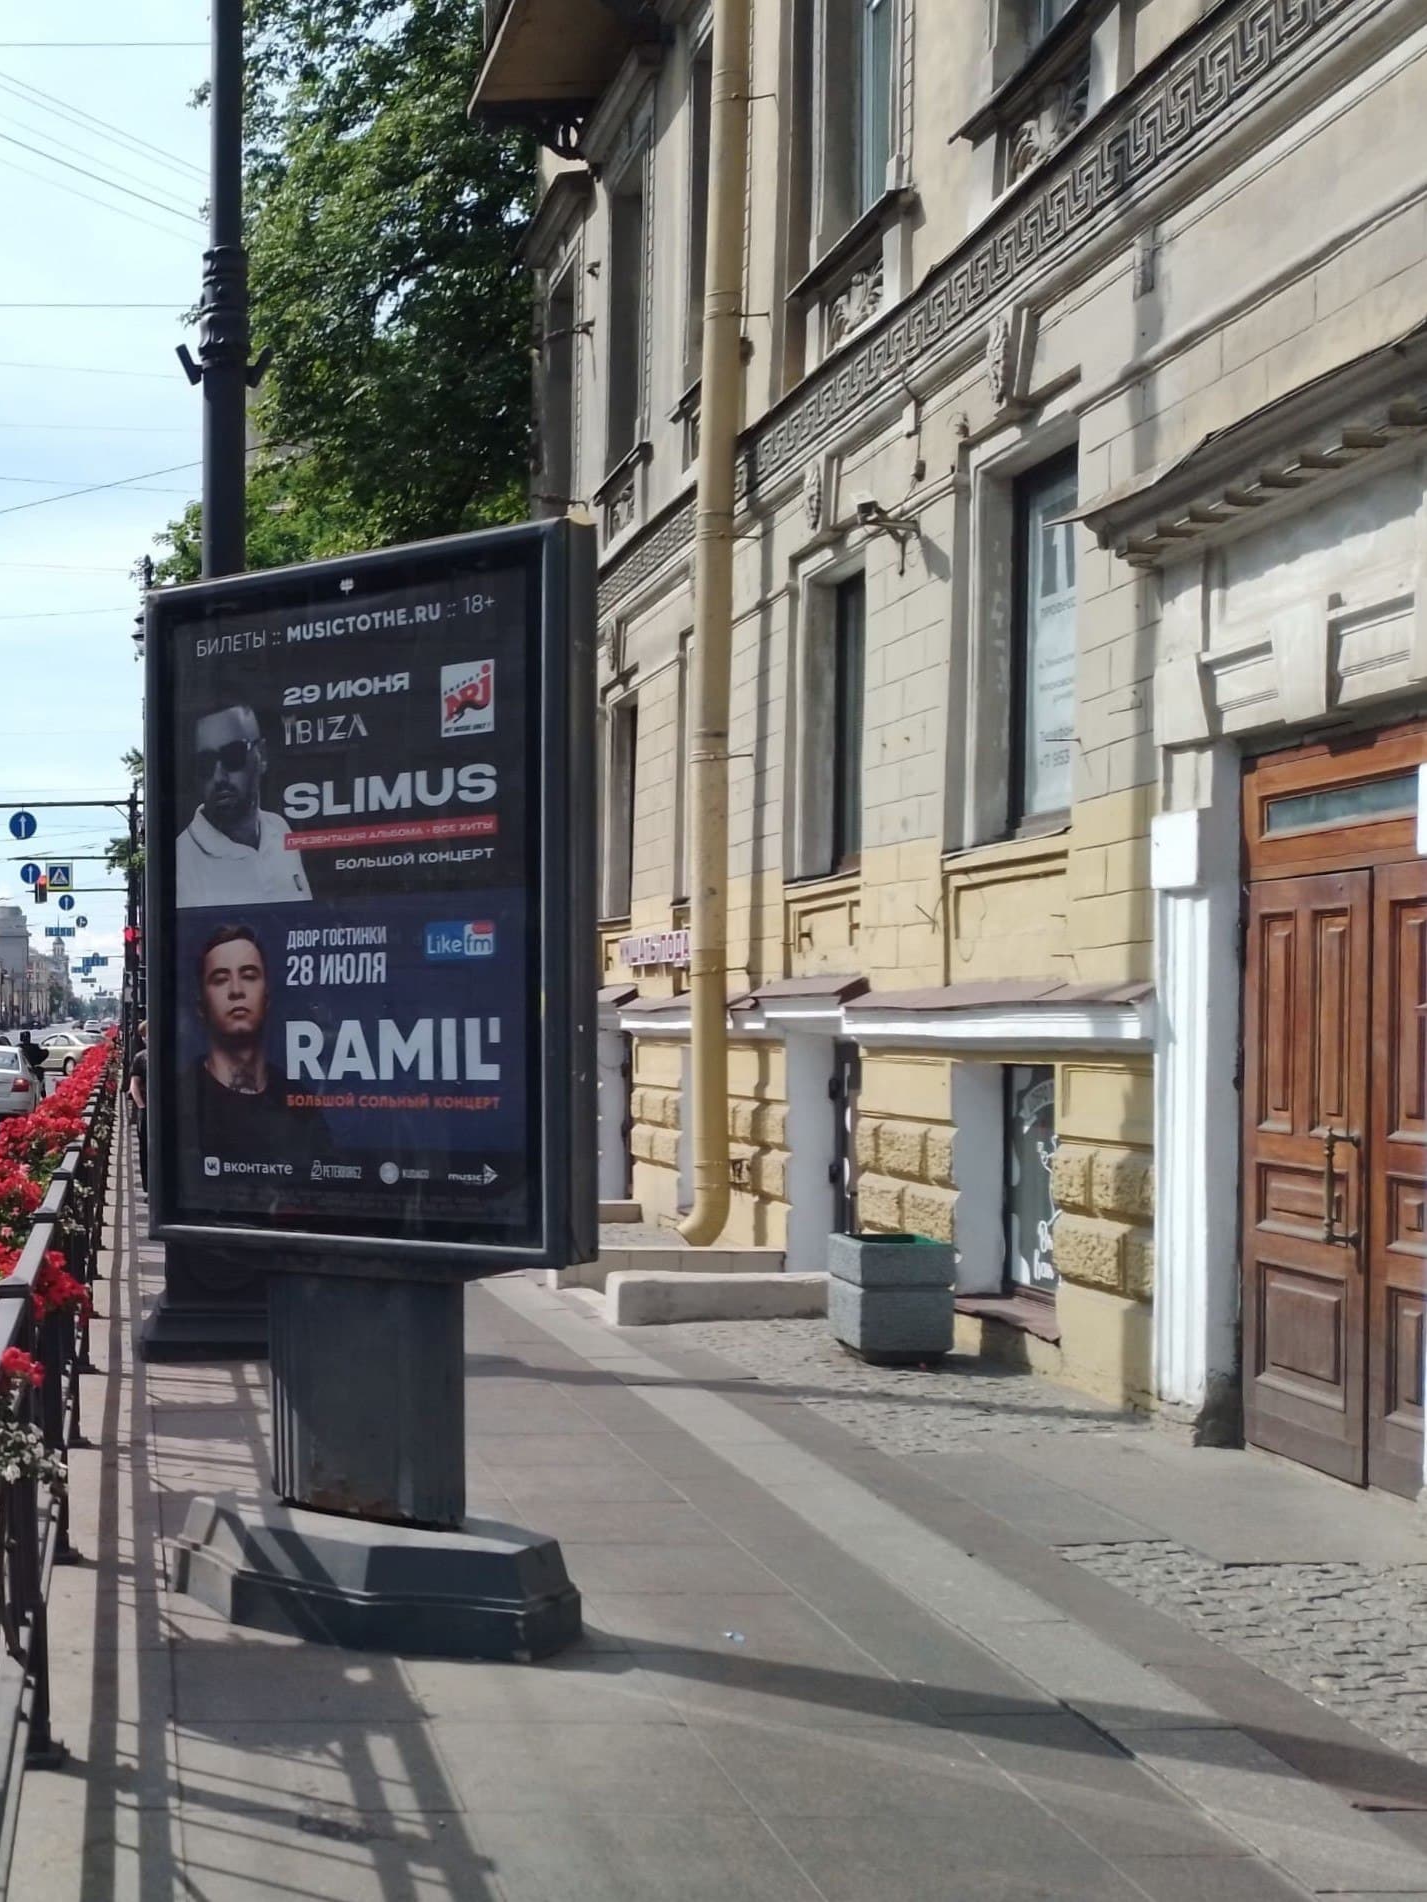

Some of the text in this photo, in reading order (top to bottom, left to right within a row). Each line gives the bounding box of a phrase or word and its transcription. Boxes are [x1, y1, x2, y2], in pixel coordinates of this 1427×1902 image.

[196, 630, 266, 657] БИЛЕТЫ
[287, 603, 441, 642] MUSICTOTHE.RU
[462, 595, 495, 614] 18+
[283, 672, 410, 705] 29 ИЮНЯ
[283, 763, 497, 819] SLIMUS
[287, 822, 494, 845] ПРЕЗЕНТАЦИЯ АЛЬБОМА ВСЕ ХИТЫ
[335, 848, 494, 870] БОЛЬШОЙ КОНЦЕРТ
[286, 926, 387, 950] ДВОР ГОСТИНКИ
[427, 935, 462, 954] Like
[286, 952, 387, 986] 28 ИЮЛЯ
[287, 1092, 501, 1110] БОЛЬШОЙ СОЛЬНЫЙ КОНЦЕРТ
